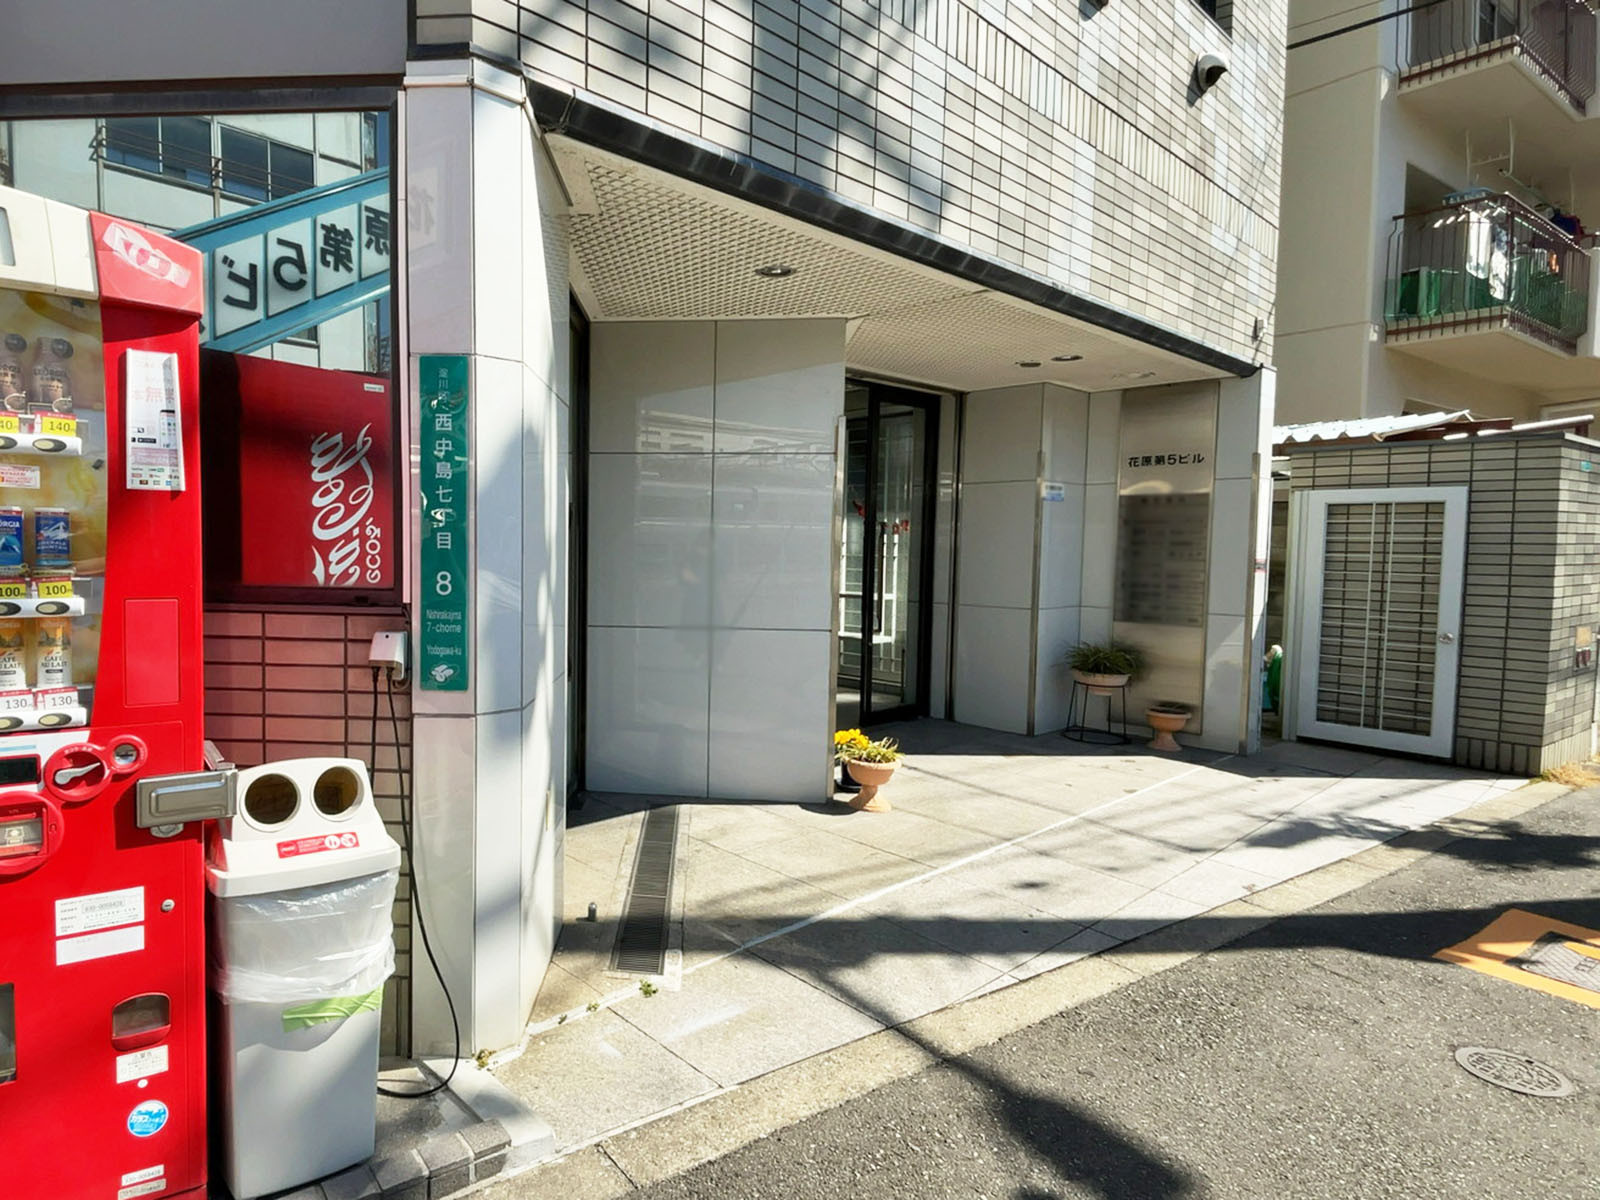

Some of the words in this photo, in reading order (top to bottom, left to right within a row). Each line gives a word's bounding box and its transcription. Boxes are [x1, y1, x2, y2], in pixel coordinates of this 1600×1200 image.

[49, 421, 71, 432] 140
[1128, 453, 1205, 468] 花原第5ビル
[434, 413, 453, 549] 西中島七丁目
[435, 570, 452, 596] 8
[46, 584, 67, 596] 100
[426, 621, 462, 633] 7-chome
[6, 698, 28, 709] 130
[51, 695, 73, 706] 130
